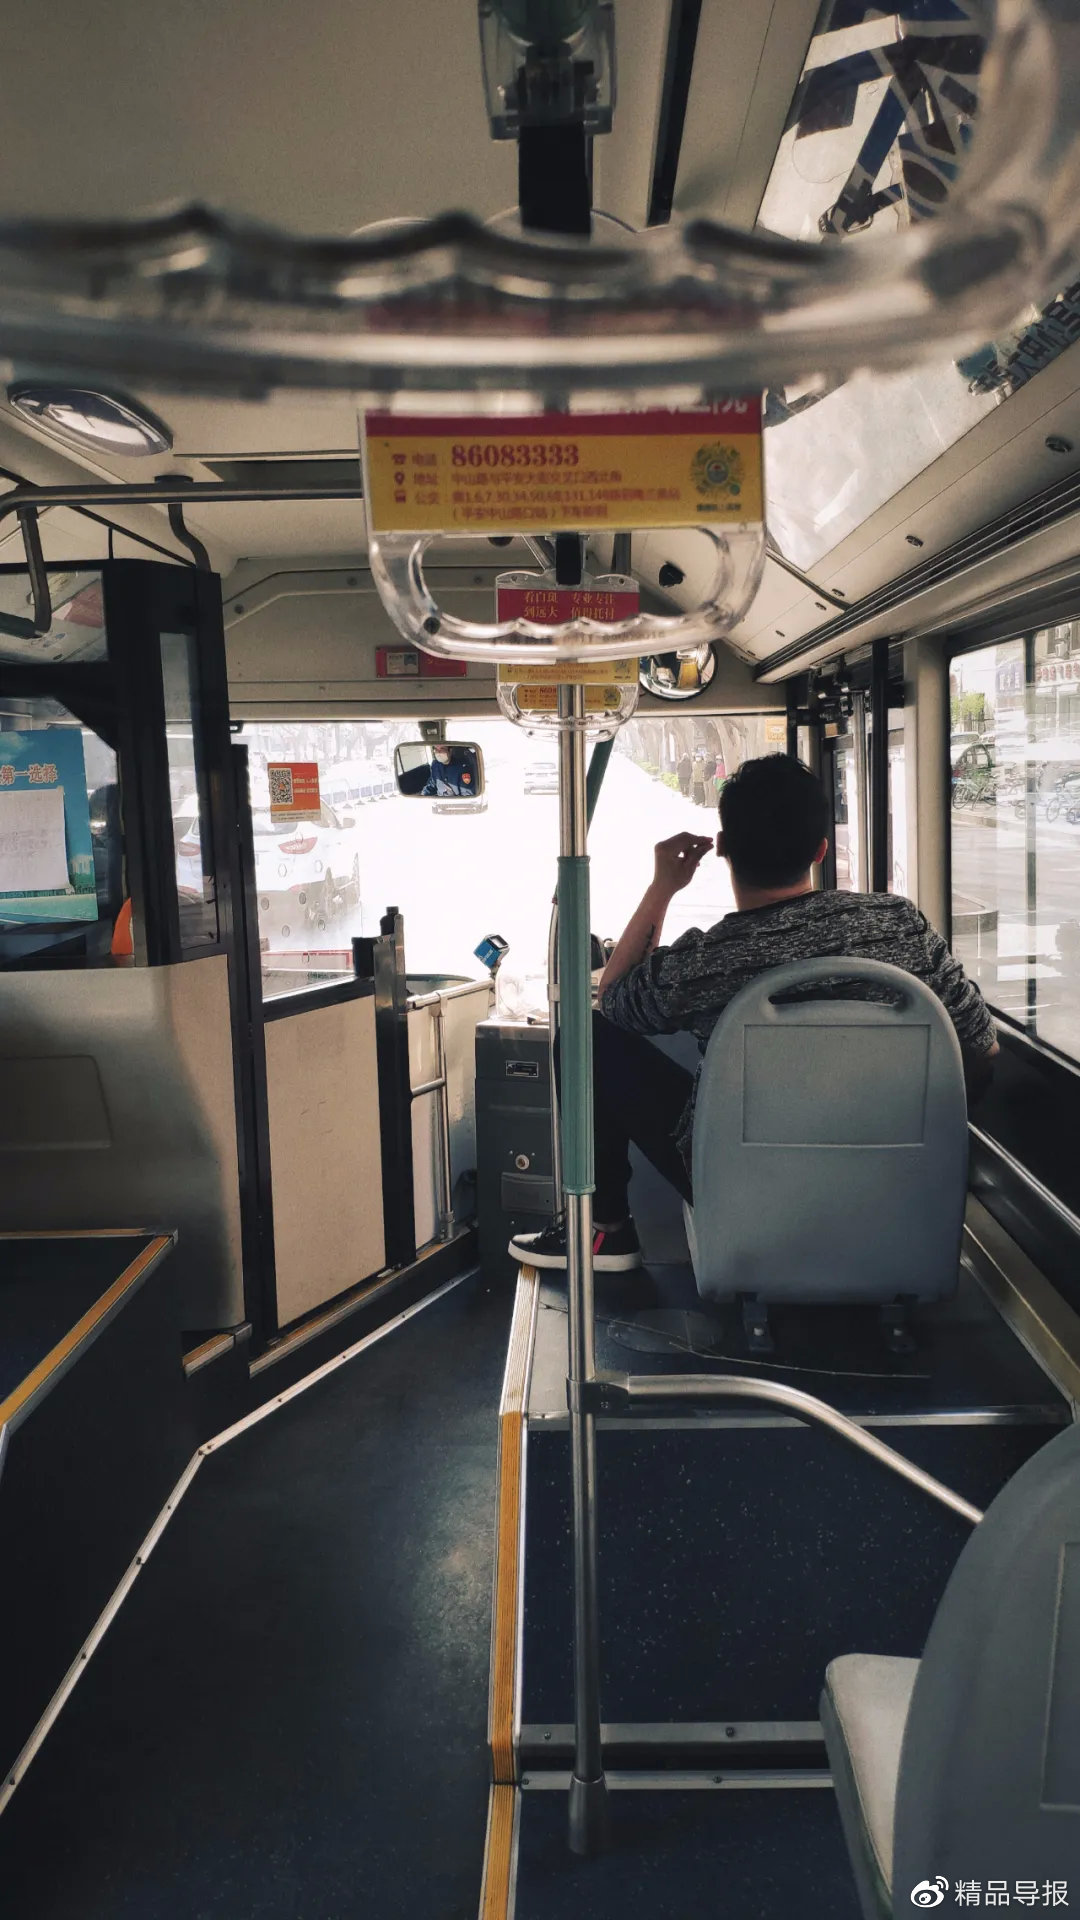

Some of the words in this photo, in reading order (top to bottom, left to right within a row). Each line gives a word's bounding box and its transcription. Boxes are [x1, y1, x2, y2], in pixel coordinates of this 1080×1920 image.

[451, 444, 580, 467] 86083333
[0, 763, 59, 785] 第一选择
